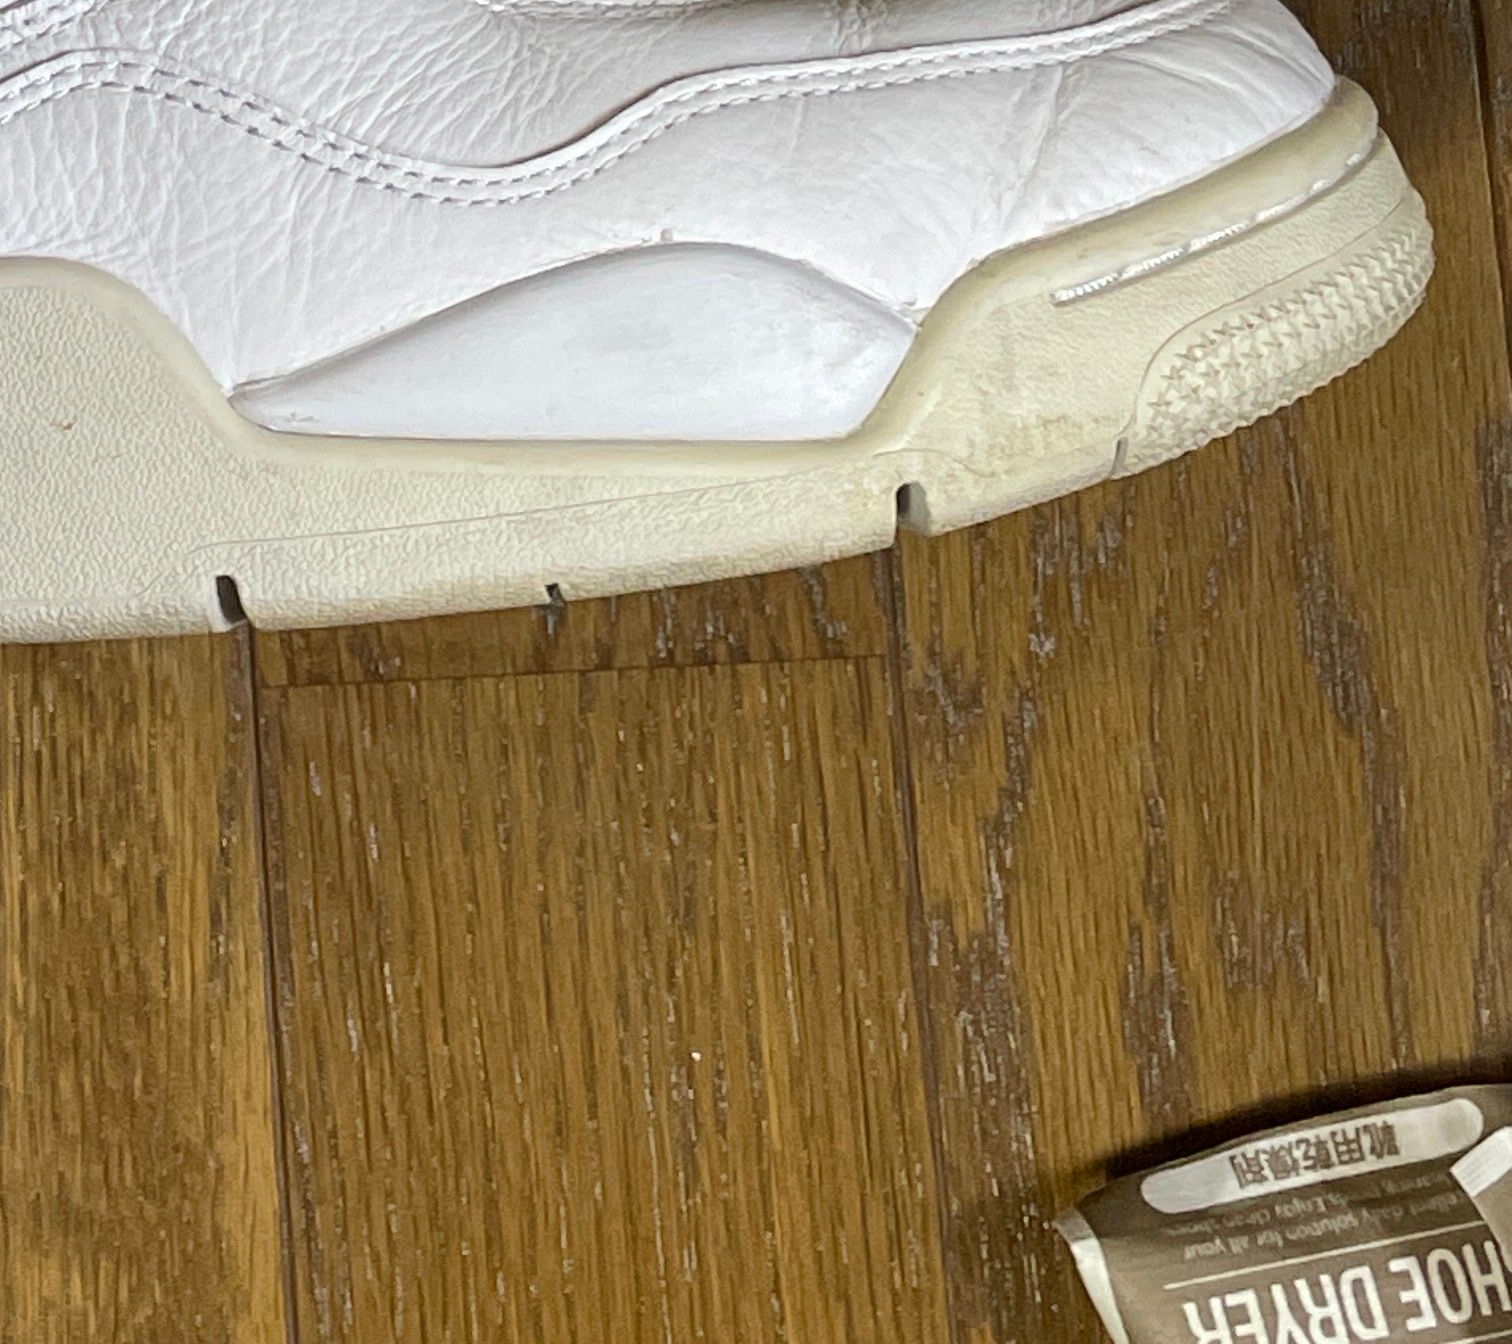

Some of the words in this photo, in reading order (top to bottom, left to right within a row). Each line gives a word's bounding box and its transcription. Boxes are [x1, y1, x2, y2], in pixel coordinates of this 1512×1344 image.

[1229, 1120, 1400, 1189] 靴用乾燥剤
[1182, 1265, 1390, 1344] DRYER
